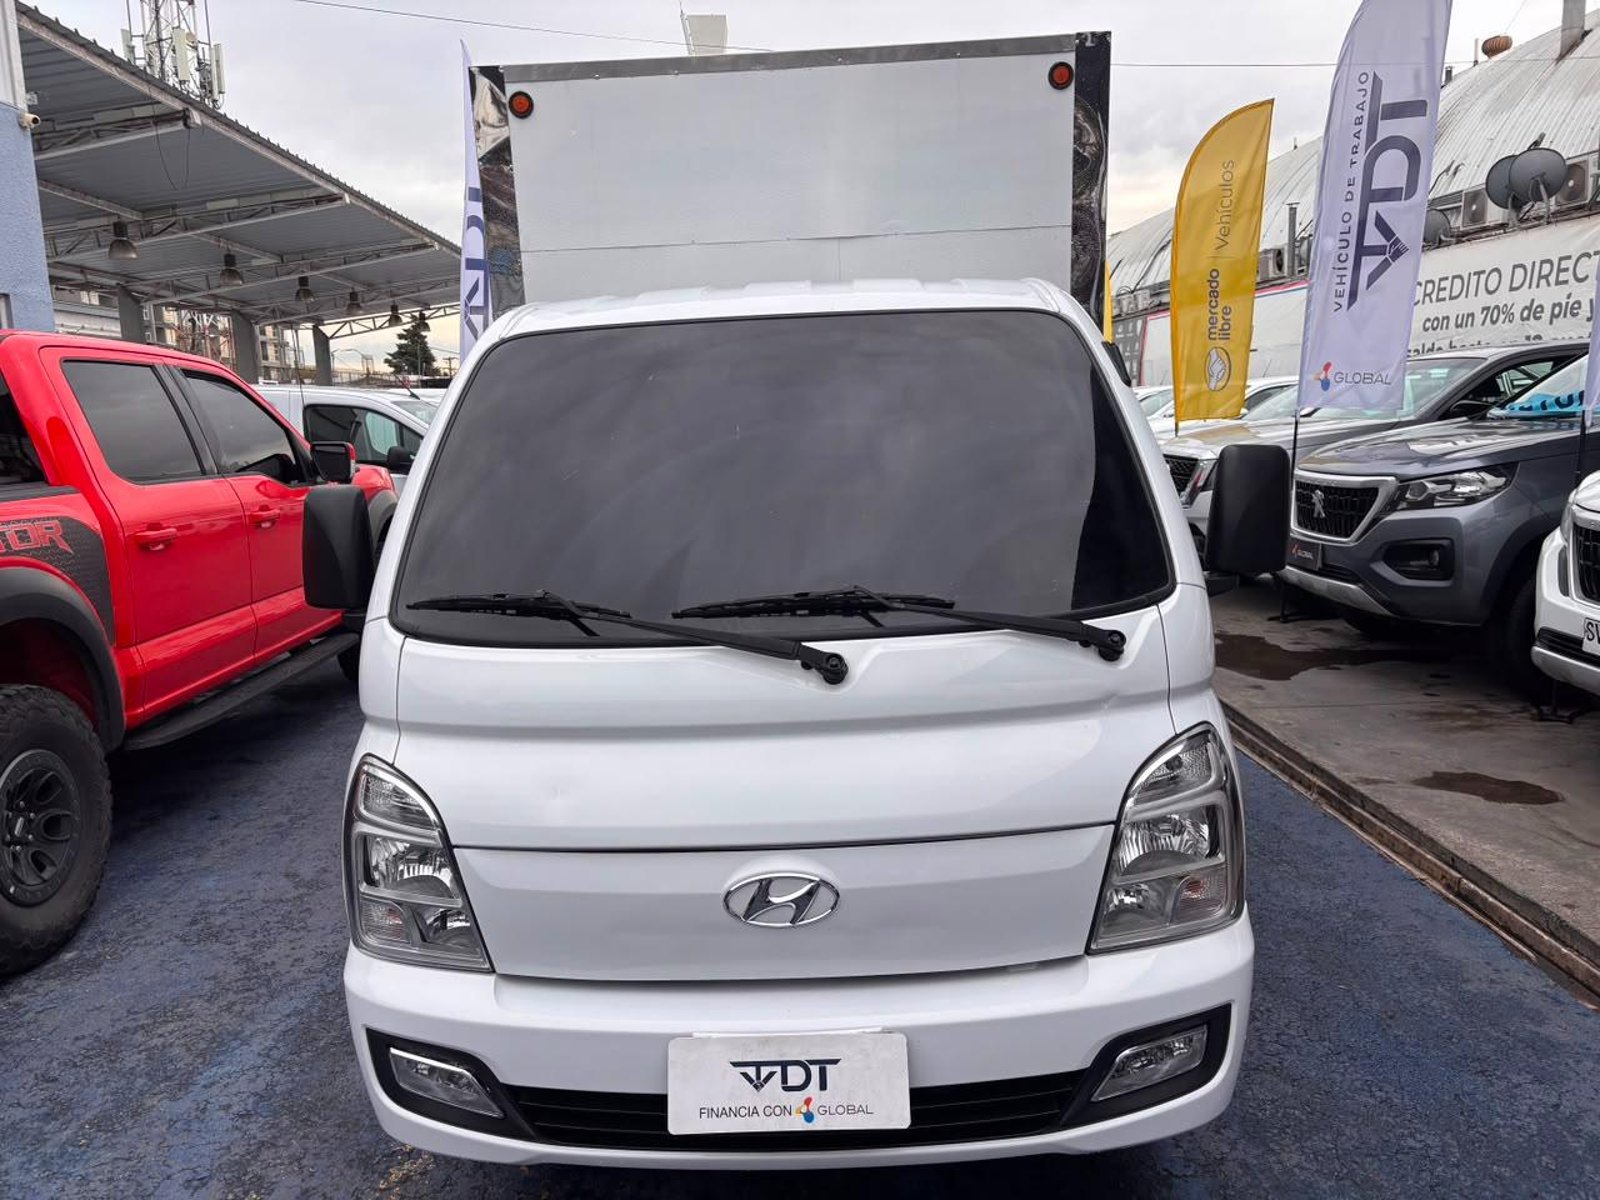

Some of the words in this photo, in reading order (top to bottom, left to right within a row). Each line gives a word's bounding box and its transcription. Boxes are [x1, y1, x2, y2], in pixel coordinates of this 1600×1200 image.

[1350, 71, 1370, 169] TRABAJO
[1215, 159, 1235, 251] Vehículos
[1345, 176, 1356, 202] DE
[1333, 211, 1353, 312] VEHÍCULO
[1508, 250, 1600, 293] DIREC
[1207, 268, 1220, 341] mercado
[1217, 305, 1232, 341] libre
[1422, 315, 1450, 332] con
[1454, 311, 1476, 329] un
[1480, 302, 1515, 327] 70%
[1519, 298, 1544, 323] de
[1333, 371, 1392, 386] GLOBAL
[699, 1105, 760, 1119] FINANCIA
[763, 1104, 792, 1117] CON
[817, 1103, 874, 1116] GLOBAL
